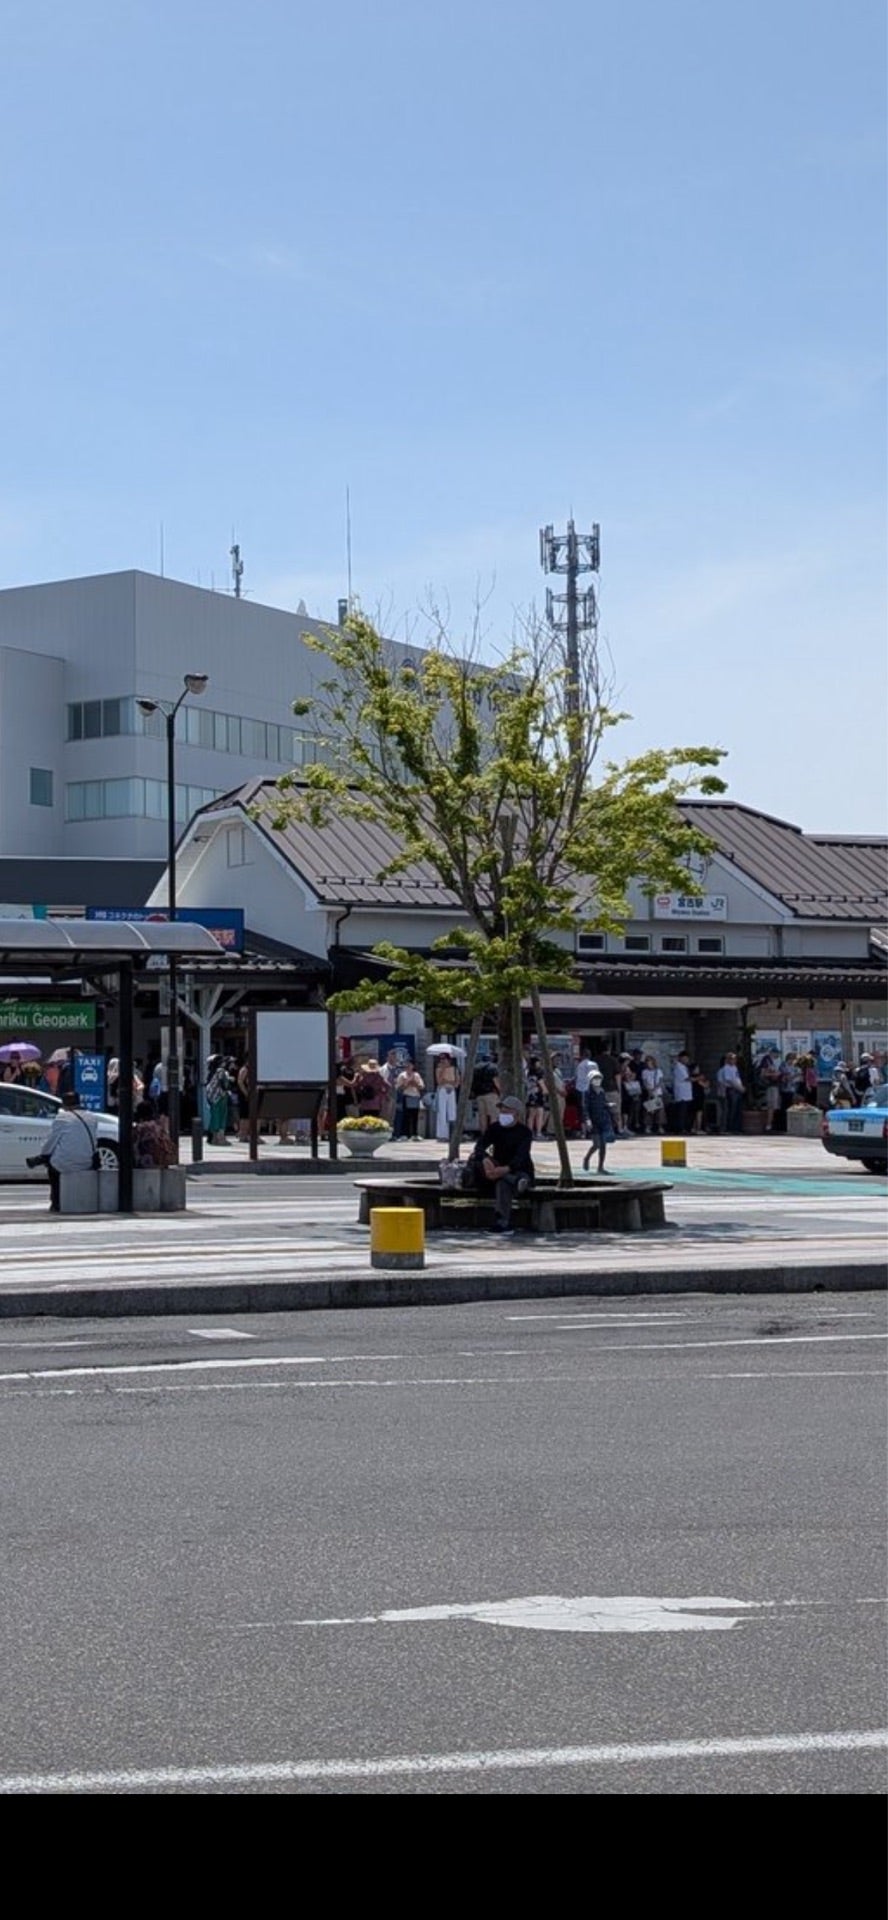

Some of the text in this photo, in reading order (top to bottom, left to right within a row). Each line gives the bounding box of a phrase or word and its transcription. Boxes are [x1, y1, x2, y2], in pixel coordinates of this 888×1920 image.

[677, 897, 725, 909] 宮古駅 JR
[32, 1012, 89, 1028] Geopark
[78, 1058, 101, 1067] TAXI
